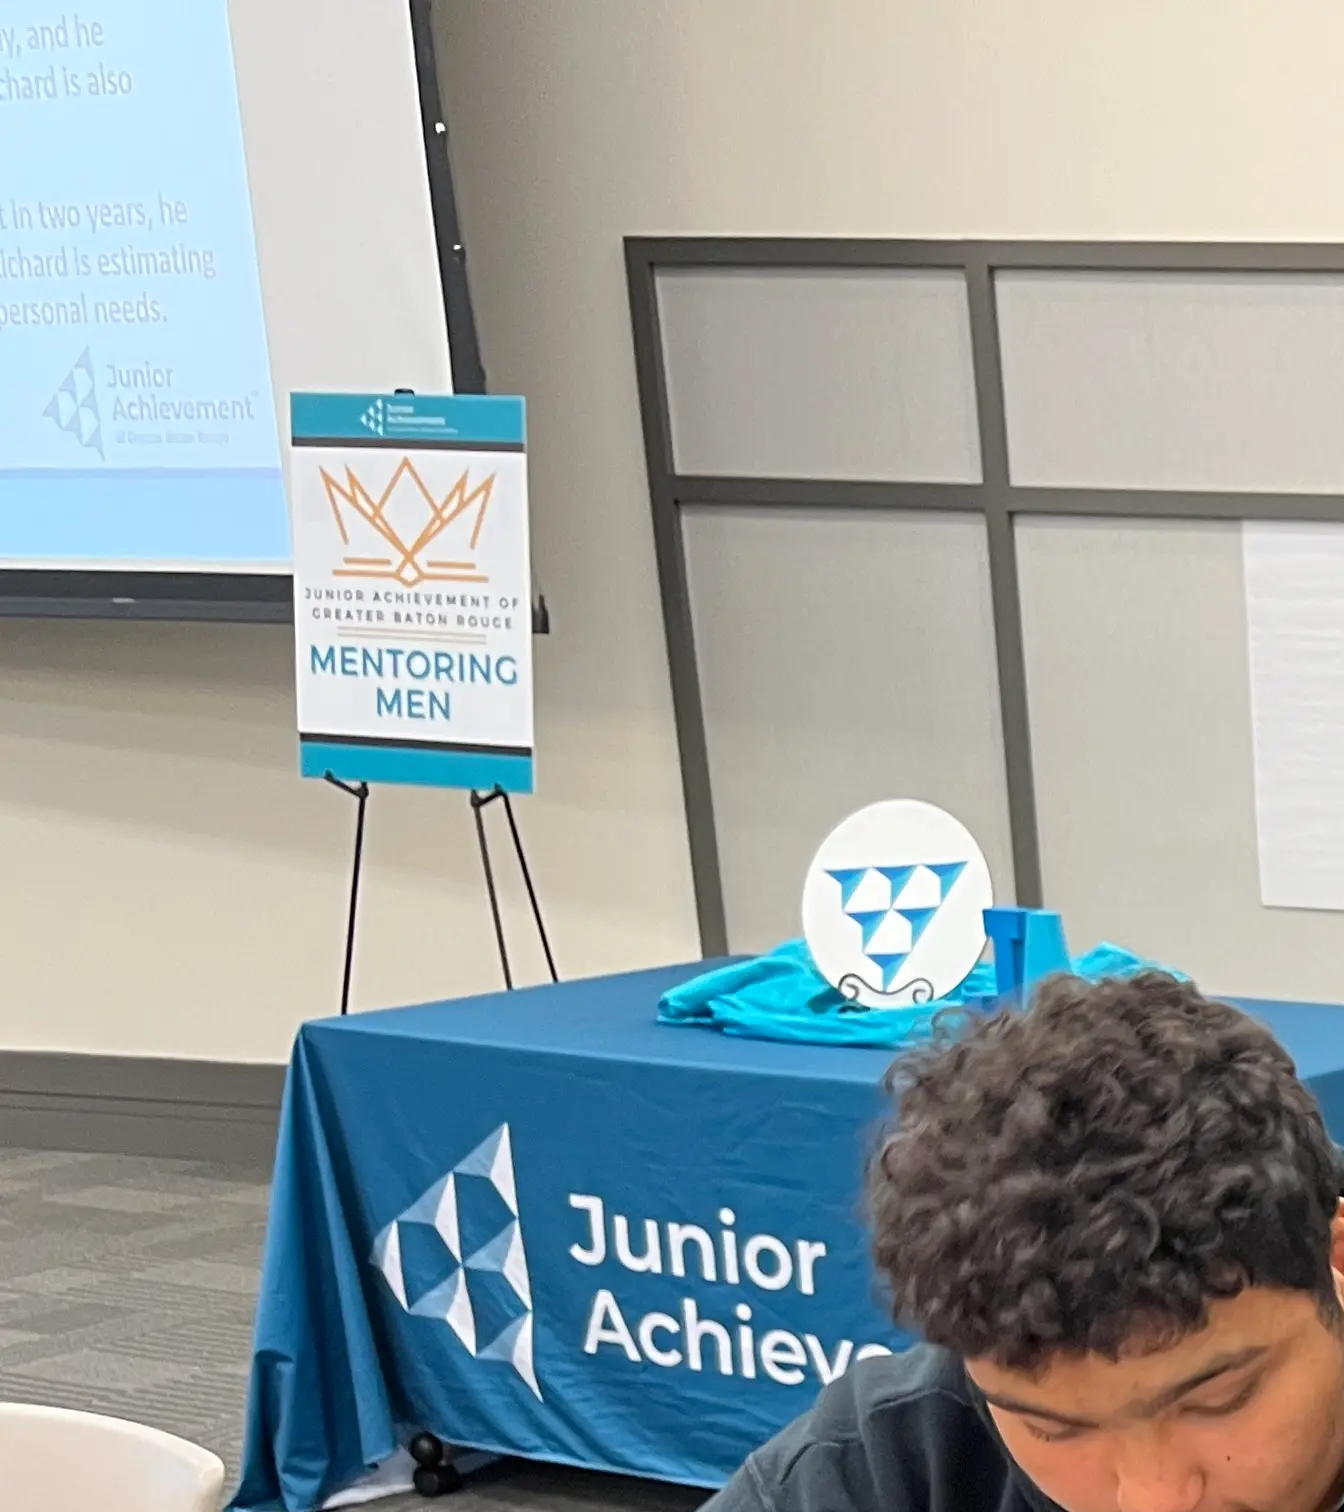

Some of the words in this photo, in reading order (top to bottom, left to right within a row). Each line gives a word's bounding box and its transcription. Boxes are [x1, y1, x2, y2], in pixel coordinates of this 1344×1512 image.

[27, 14, 69, 50] and
[74, 13, 104, 48] he
[62, 65, 81, 97] is
[87, 61, 132, 96] also
[12, 199, 33, 229] in
[39, 201, 81, 229] two
[86, 202, 153, 234] years,
[158, 191, 187, 226] he
[0, 247, 69, 279] ichard
[74, 247, 92, 276] is
[98, 243, 216, 280] estimating
[94, 291, 168, 324] needs.
[106, 360, 173, 388] Junior
[113, 394, 256, 422] Achievement
[304, 587, 365, 602] JUNIOR
[372, 591, 490, 609] ACHIEVEMENT
[499, 596, 519, 610] OF
[312, 607, 385, 622] GREATER
[394, 611, 449, 627] BATON
[456, 614, 513, 630] ROUGE
[310, 643, 518, 686] MENTORING
[375, 687, 452, 722] MEN
[568, 1192, 827, 1297] Junior
